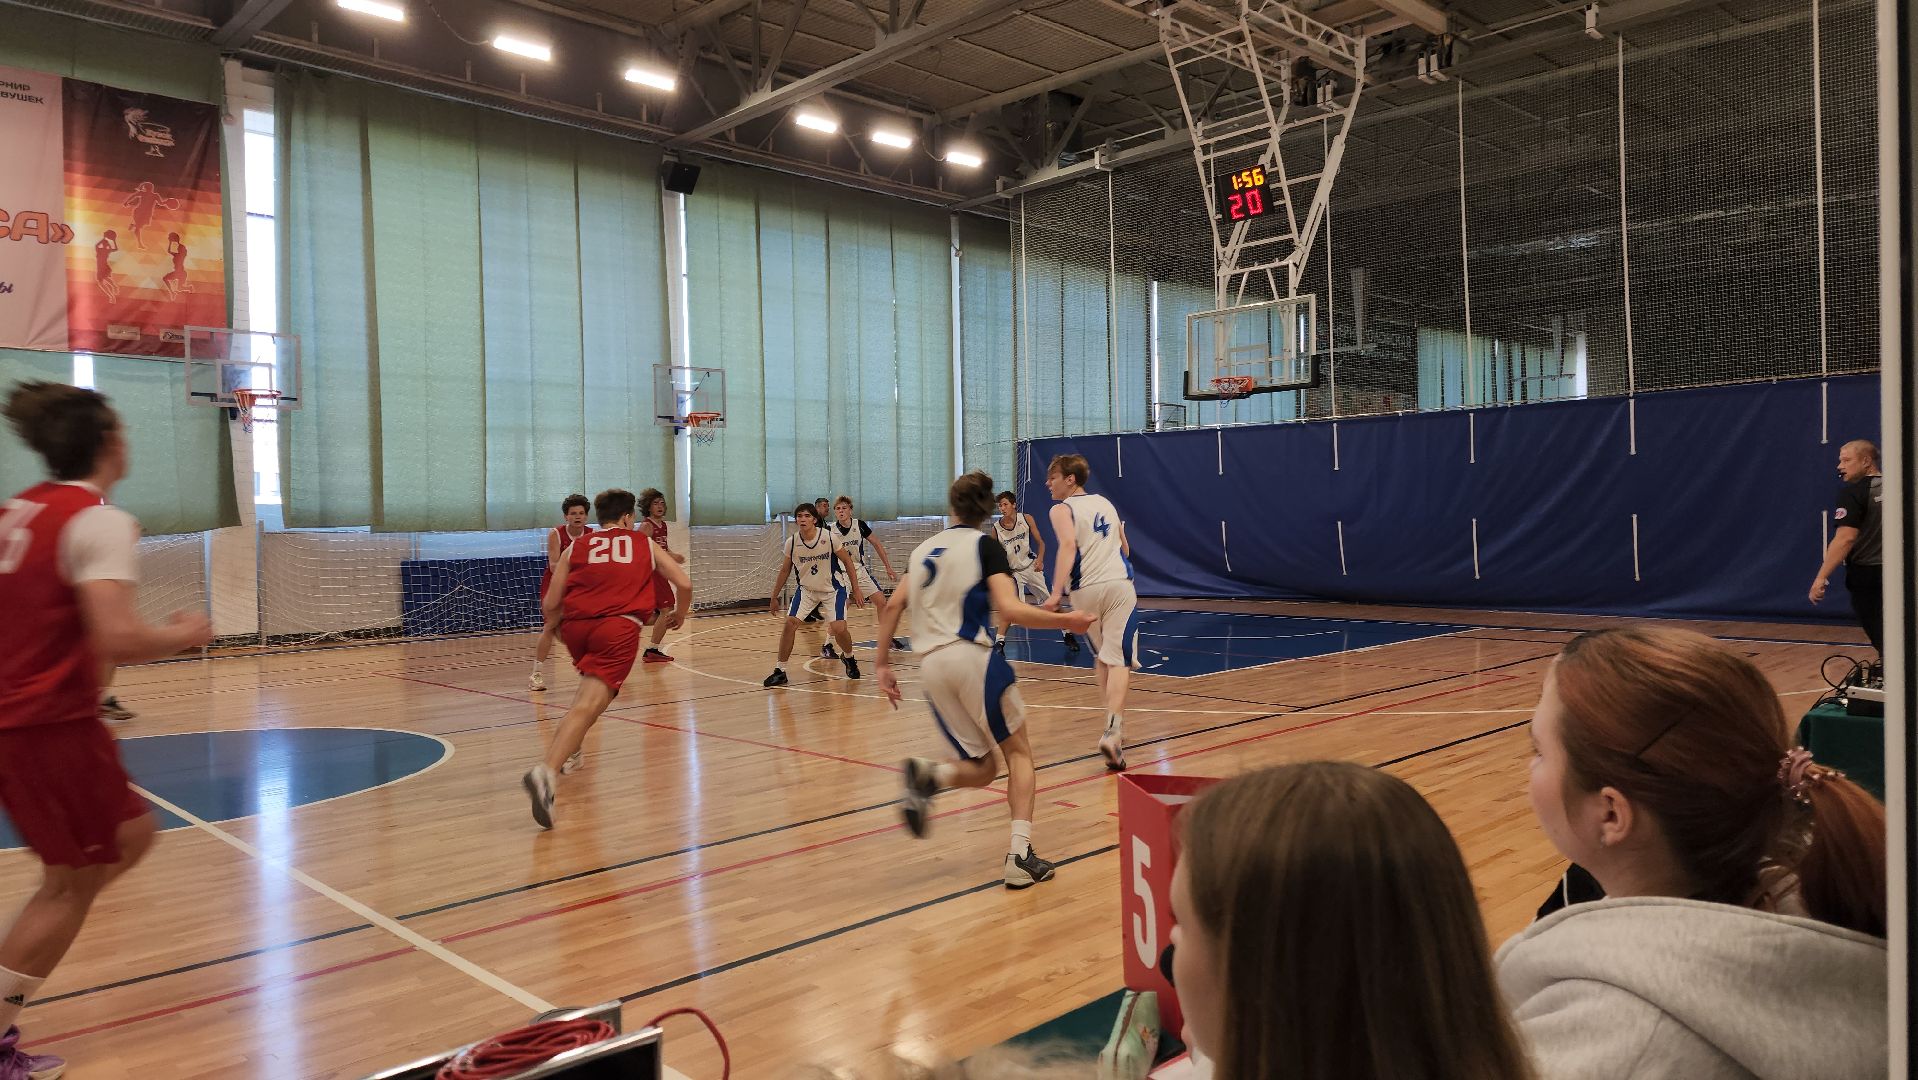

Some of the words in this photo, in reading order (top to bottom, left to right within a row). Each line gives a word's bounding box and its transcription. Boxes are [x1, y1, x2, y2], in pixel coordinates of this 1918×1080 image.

[1231, 168, 1264, 190] 1:56
[1228, 189, 1264, 219] 20
[1092, 511, 1111, 539] 4
[588, 534, 633, 564] 20
[810, 563, 819, 576] 8
[921, 547, 948, 590] 5
[1132, 834, 1157, 969] 5
